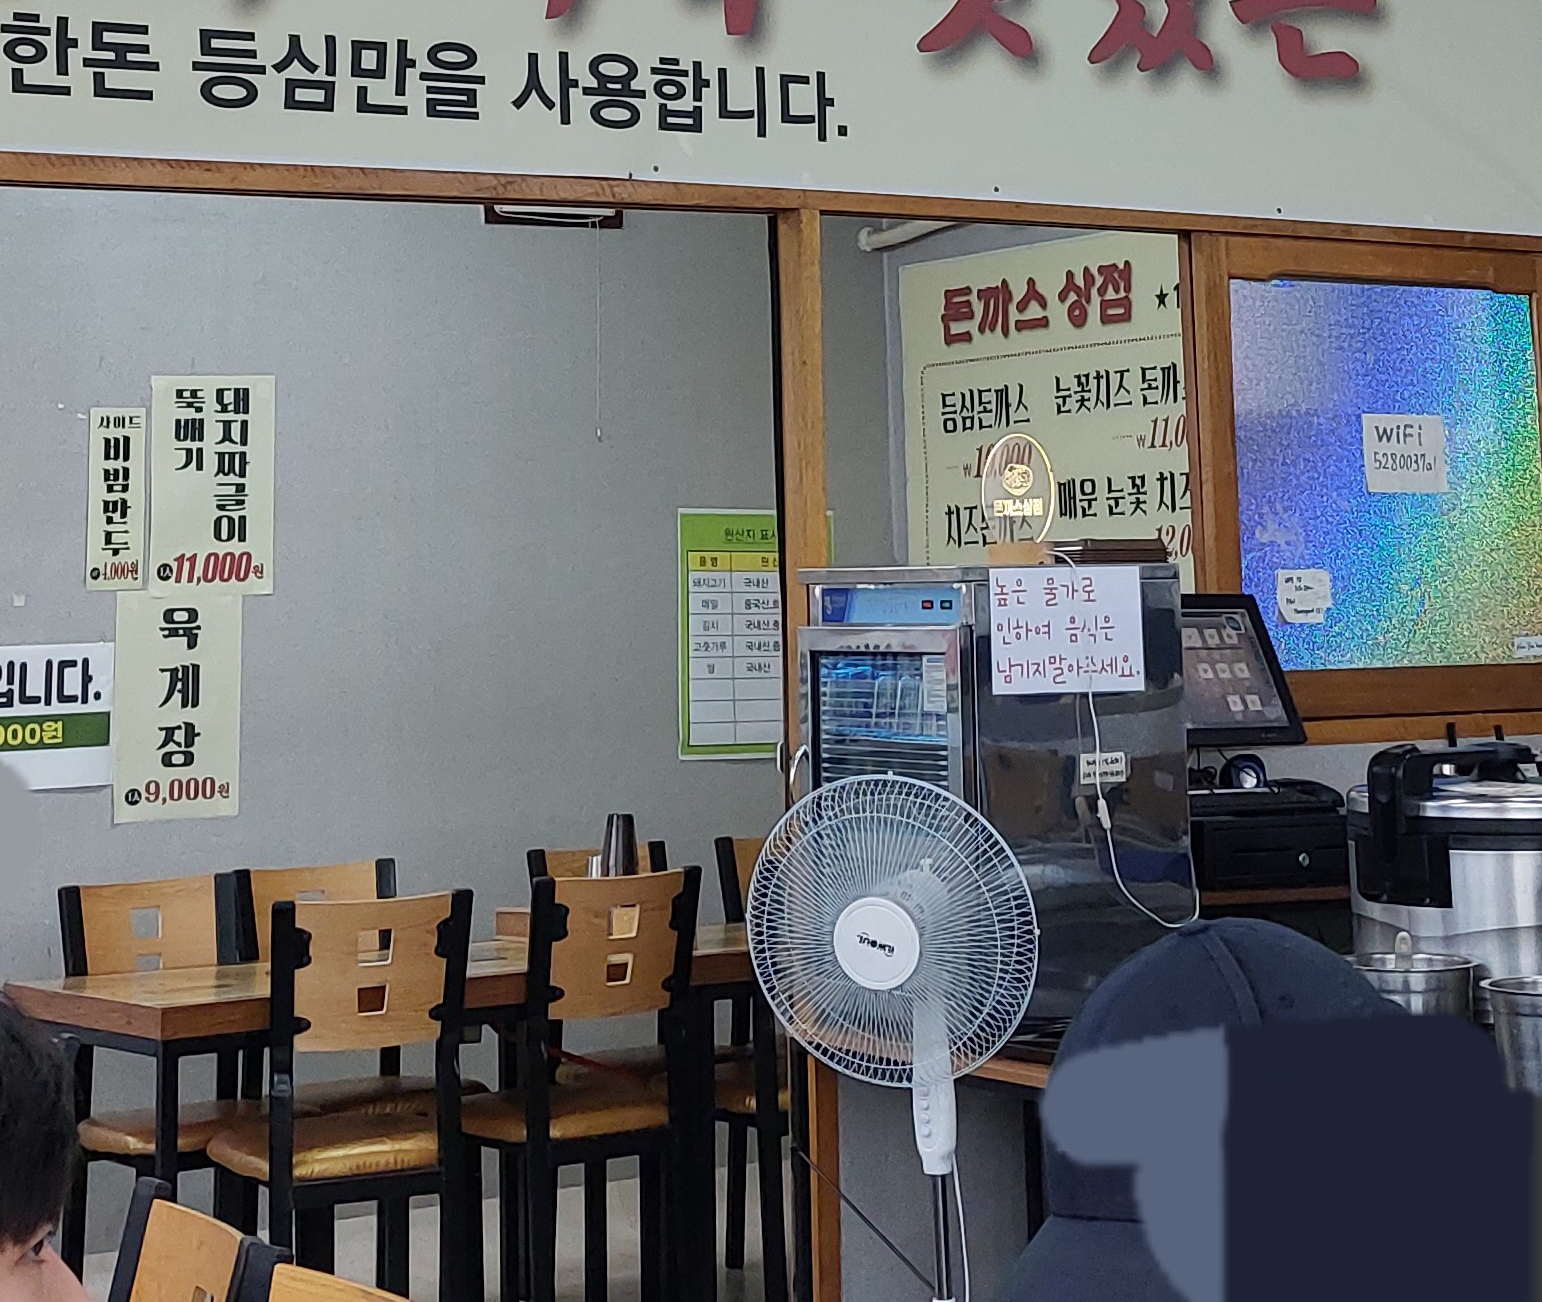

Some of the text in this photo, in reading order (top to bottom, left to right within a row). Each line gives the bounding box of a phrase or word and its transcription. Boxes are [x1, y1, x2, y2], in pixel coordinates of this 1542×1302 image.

[191, 29, 480, 120] 등심만을
[511, 53, 849, 142] 사용합니다.
[941, 277, 1049, 346] 돈까스
[1058, 260, 1132, 327] 상점
[940, 383, 1030, 433] 등심돈까스
[1054, 362, 1187, 415] 눈꽃치즈 돈까
[98, 415, 141, 429] 사이드
[174, 388, 206, 472] 뚝배기
[213, 387, 250, 543] 돼지짜글이
[101, 435, 131, 557] 비빔만두
[1057, 478, 1097, 520] 매운
[1106, 474, 1147, 517] 눈꽃
[173, 551, 264, 586] 11,000원
[994, 577, 1096, 607] 높은 물가로
[997, 615, 1115, 644] 인하여 음식은
[157, 607, 202, 768] 육계장
[145, 777, 229, 805] 9,000원
